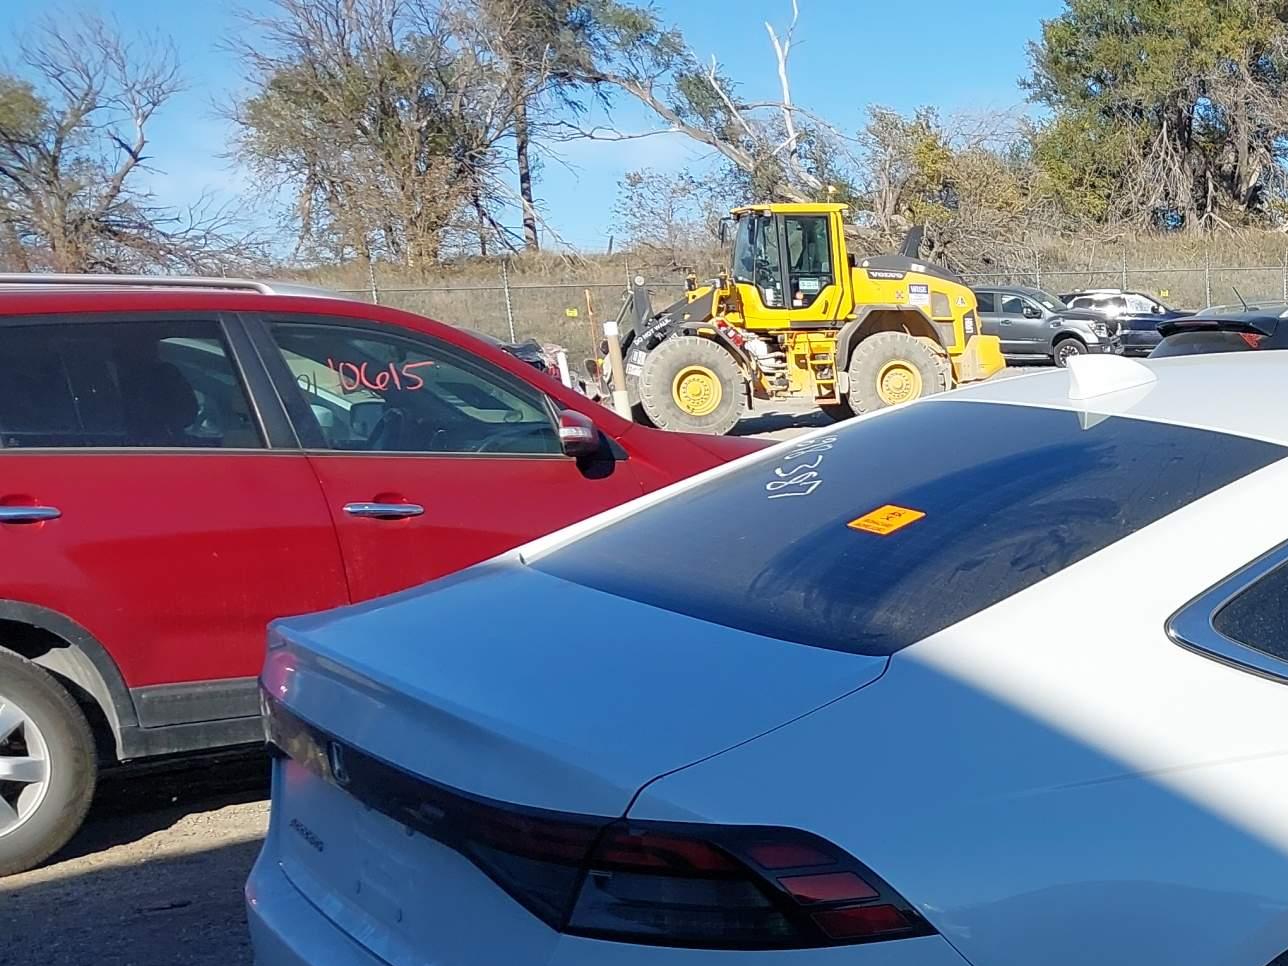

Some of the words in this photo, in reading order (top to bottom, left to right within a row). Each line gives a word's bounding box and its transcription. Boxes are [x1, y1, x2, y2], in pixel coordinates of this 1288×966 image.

[869, 271, 903, 279] VOLVO
[634, 337, 643, 346] DO
[642, 328, 655, 340] NOT
